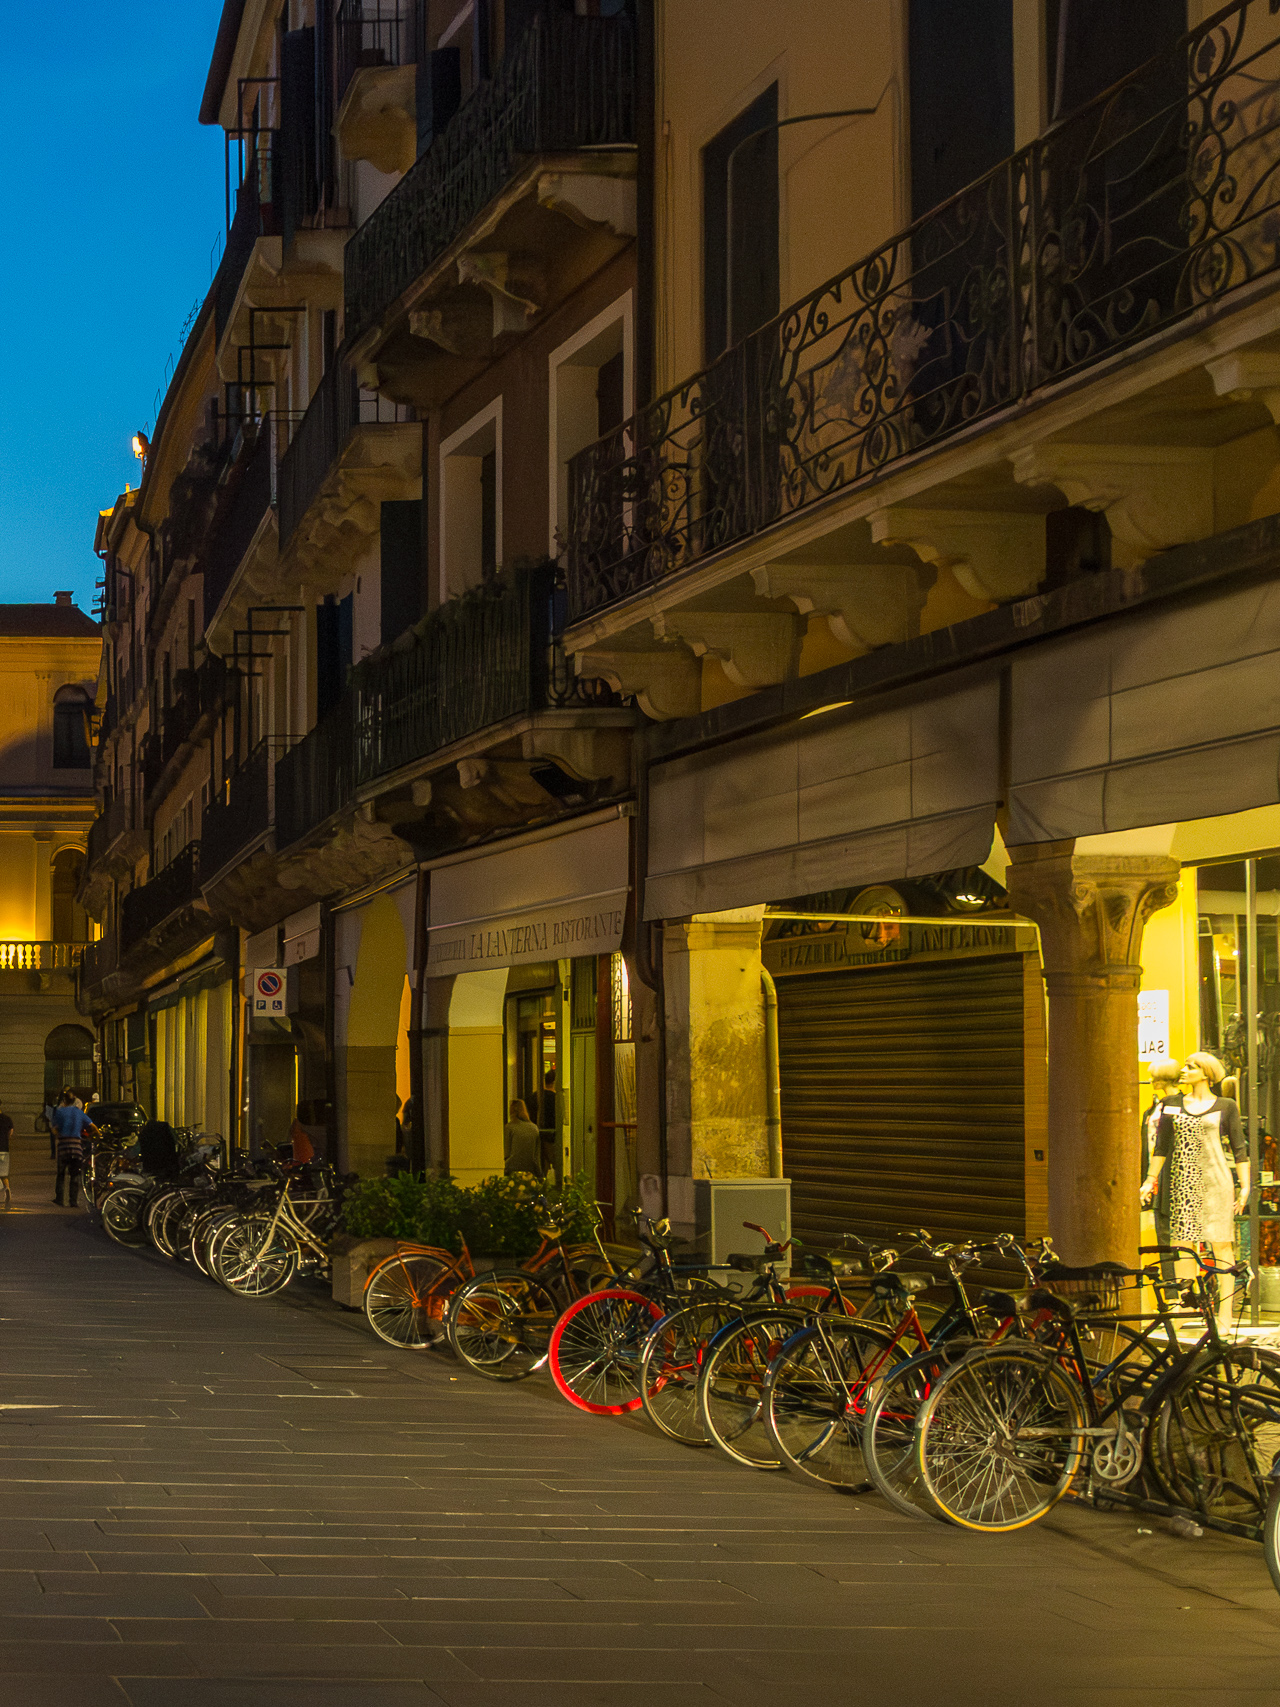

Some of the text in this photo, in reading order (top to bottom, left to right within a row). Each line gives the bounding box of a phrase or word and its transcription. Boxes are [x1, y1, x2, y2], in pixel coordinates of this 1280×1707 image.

[469, 932, 484, 960] LA
[486, 922, 549, 958] LANTERNA
[552, 910, 622, 946] RISTORANTE
